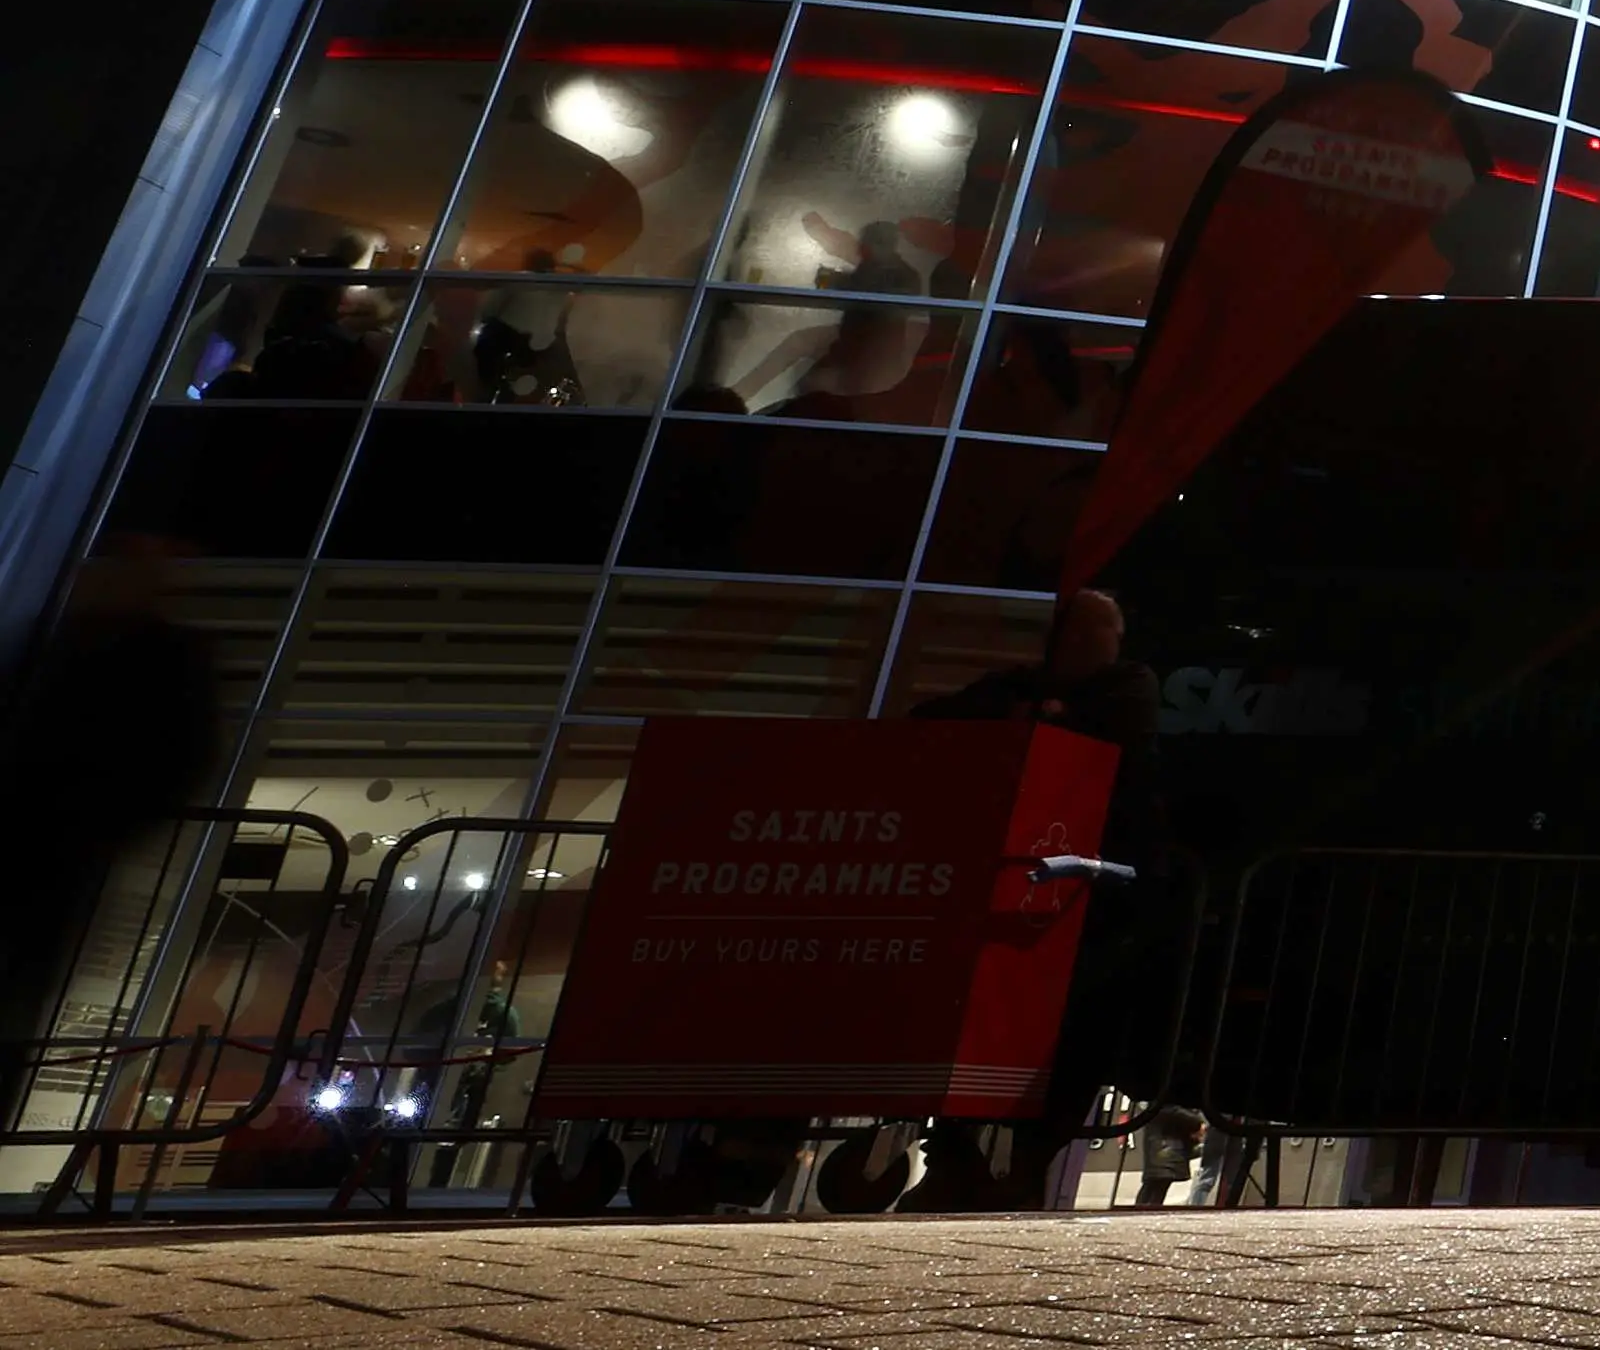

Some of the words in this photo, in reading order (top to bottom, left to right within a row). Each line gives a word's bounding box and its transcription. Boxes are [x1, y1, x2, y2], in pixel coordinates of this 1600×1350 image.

[728, 809, 904, 845] SAINTS
[650, 860, 957, 898] PROGRAMMES
[631, 937, 697, 965] BUY
[715, 936, 821, 965] YOURS
[838, 937, 932, 965] HERE
